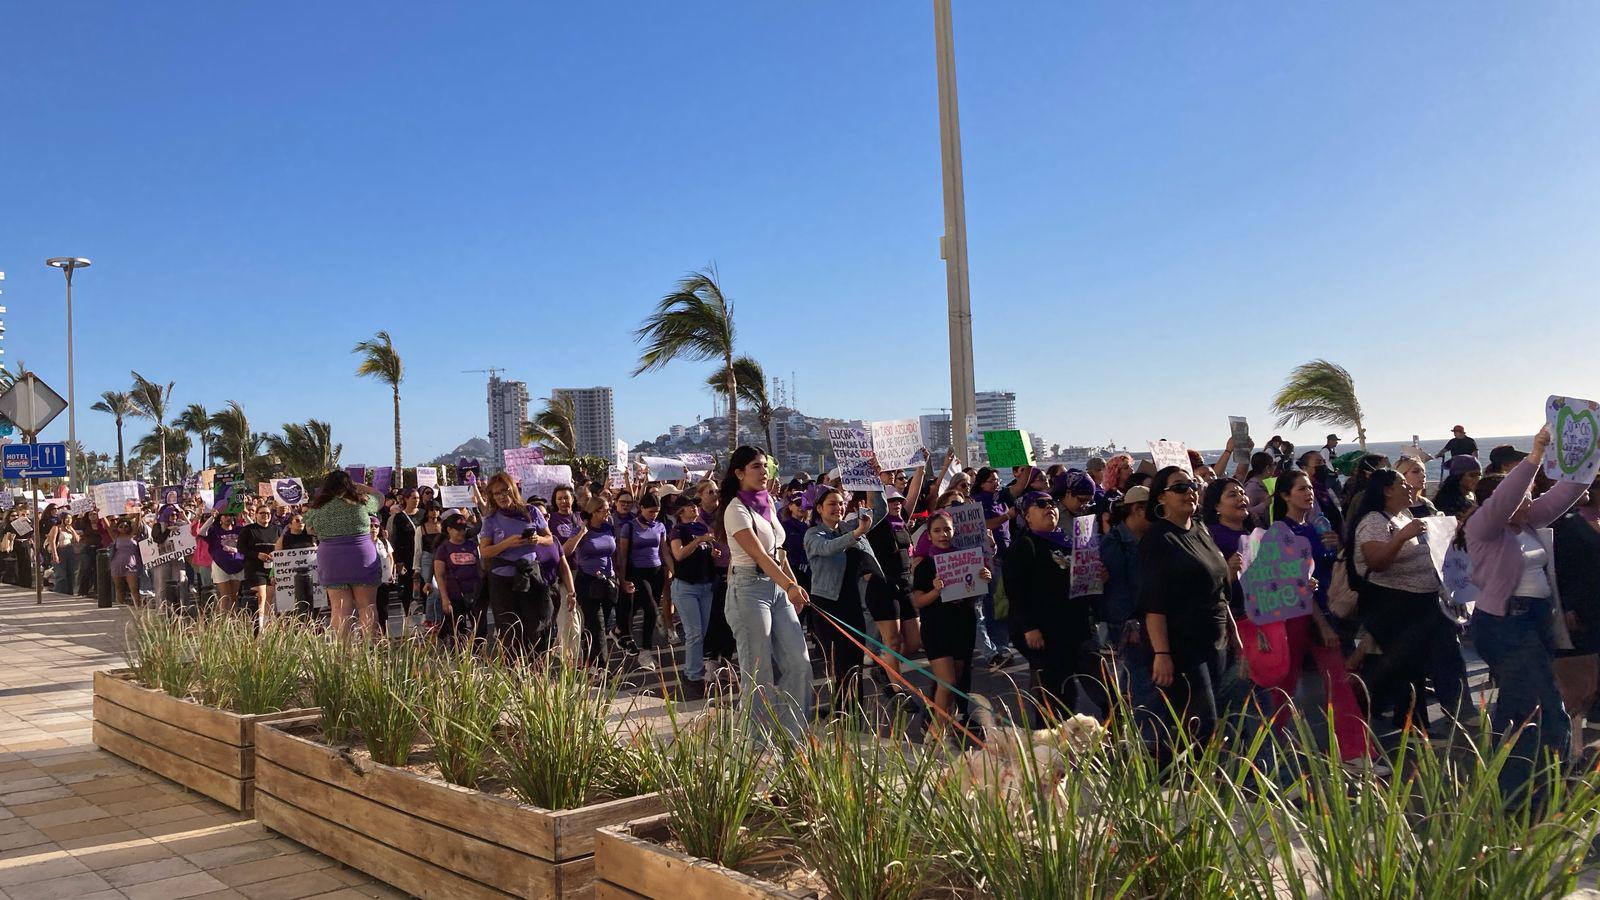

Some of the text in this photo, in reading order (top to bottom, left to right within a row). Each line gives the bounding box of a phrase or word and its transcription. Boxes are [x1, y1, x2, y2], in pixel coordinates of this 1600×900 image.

[828, 429, 856, 440] LUCHA
[832, 440, 869, 449] AUNQUE LO
[833, 449, 861, 459] TENGAS
